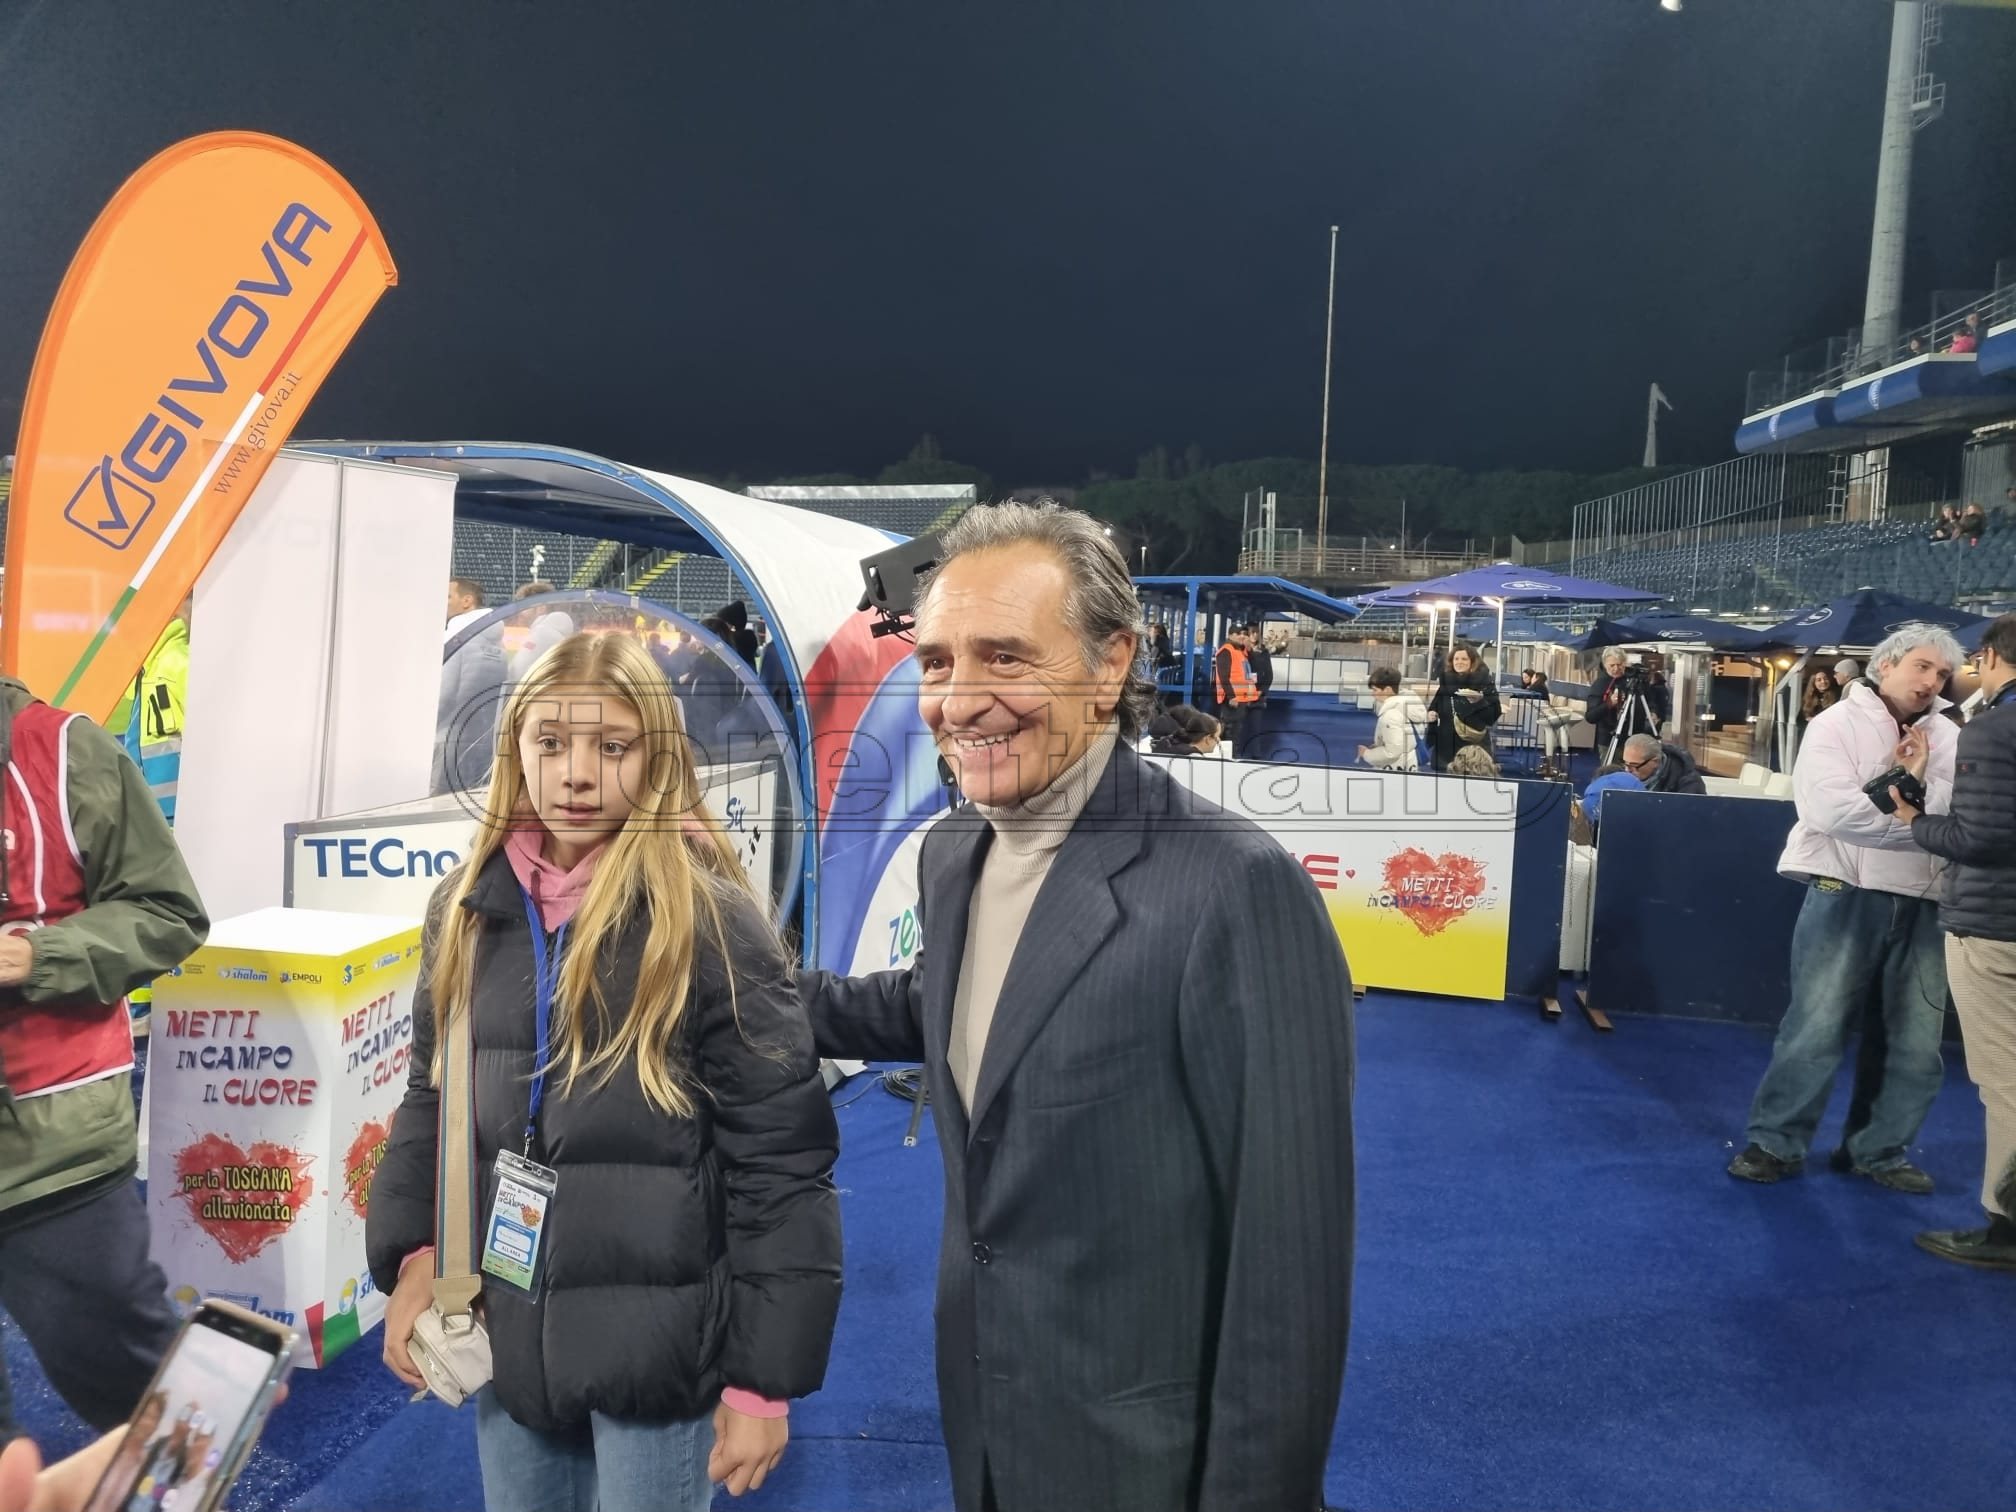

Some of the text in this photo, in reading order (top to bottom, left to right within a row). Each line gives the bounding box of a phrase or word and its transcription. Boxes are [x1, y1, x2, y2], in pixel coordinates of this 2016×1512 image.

[121, 203, 332, 483] GIVOVA
[214, 371, 302, 494] www.givova.it
[1401, 877, 1454, 893] METTI
[889, 906, 921, 967] ze
[292, 972, 322, 983] EMPOLI
[166, 1010, 260, 1039] METTI
[341, 990, 396, 1047] METTI
[373, 1042, 412, 1088] CUOR
[202, 1078, 318, 1107] IL CUORE
[184, 1164, 294, 1193] per la TOSCANA
[201, 1197, 293, 1223] alluvionata
